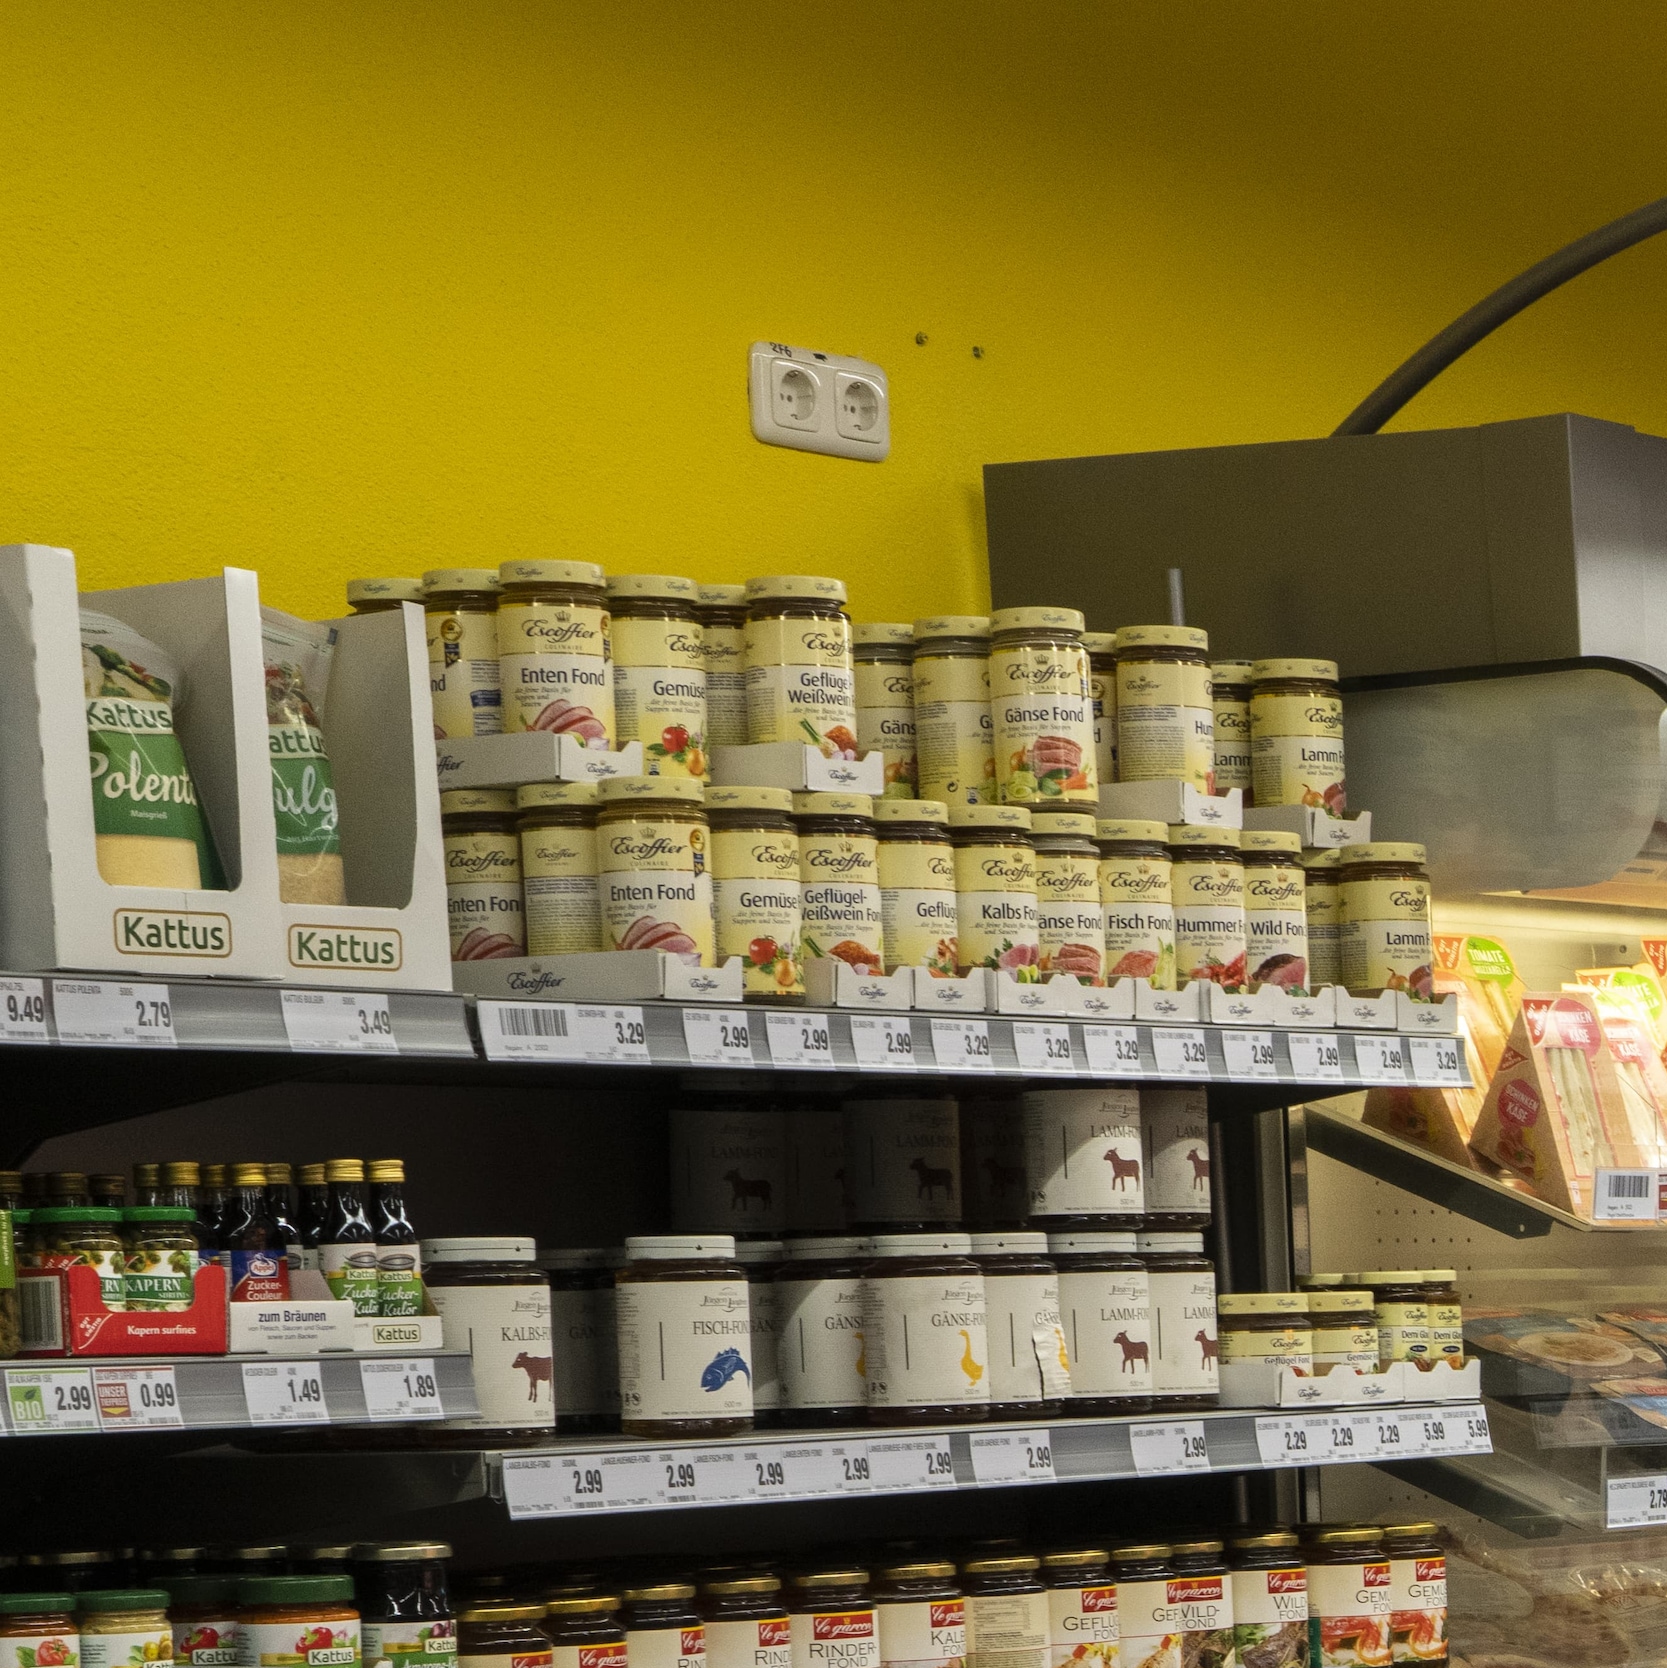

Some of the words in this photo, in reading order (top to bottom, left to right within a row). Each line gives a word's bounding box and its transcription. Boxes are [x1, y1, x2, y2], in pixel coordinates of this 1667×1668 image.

[522, 619, 599, 642] Escoffier
[522, 668, 567, 685] Enten
[571, 667, 605, 686] Fond
[1006, 661, 1076, 684] Escoffier
[87, 701, 172, 729] Kattus
[1005, 707, 1048, 723] Gänse
[1053, 706, 1084, 723] Fond
[1301, 747, 1339, 763] Lamm
[611, 836, 687, 859] Escoffier
[740, 891, 798, 909] Gemüse
[805, 888, 867, 907] Geflügel-
[982, 904, 1021, 920] Kalbs
[123, 915, 225, 950] Kattus
[1108, 914, 1145, 930] Fisch
[1147, 914, 1173, 932] Fond
[1176, 918, 1238, 934] Hummer
[1250, 920, 1282, 936] Wild
[297, 931, 395, 964] Kattus
[1467, 949, 1505, 965] TOMATE
[7, 995, 45, 1024] 9.49
[136, 1000, 172, 1028] 2.79
[358, 1009, 392, 1035] 3.49
[720, 1025, 749, 1049] 2.99
[125, 1278, 181, 1292] KAPERN
[248, 1280, 283, 1291] Zucker-
[258, 1313, 281, 1323] zum
[284, 1310, 327, 1323] Bräunen
[127, 1325, 160, 1338] Kapern
[162, 1324, 197, 1337] surfines
[376, 1326, 418, 1342] Kattus
[140, 1383, 175, 1408] 0.99
[403, 1374, 436, 1399] 1.89
[55, 1386, 92, 1411] 2.99
[1424, 1421, 1446, 1441] 5.99
[1649, 1488, 1667, 1508] 2.79
[809, 1643, 878, 1659] RINDER-
[828, 1656, 868, 1668] FOND
